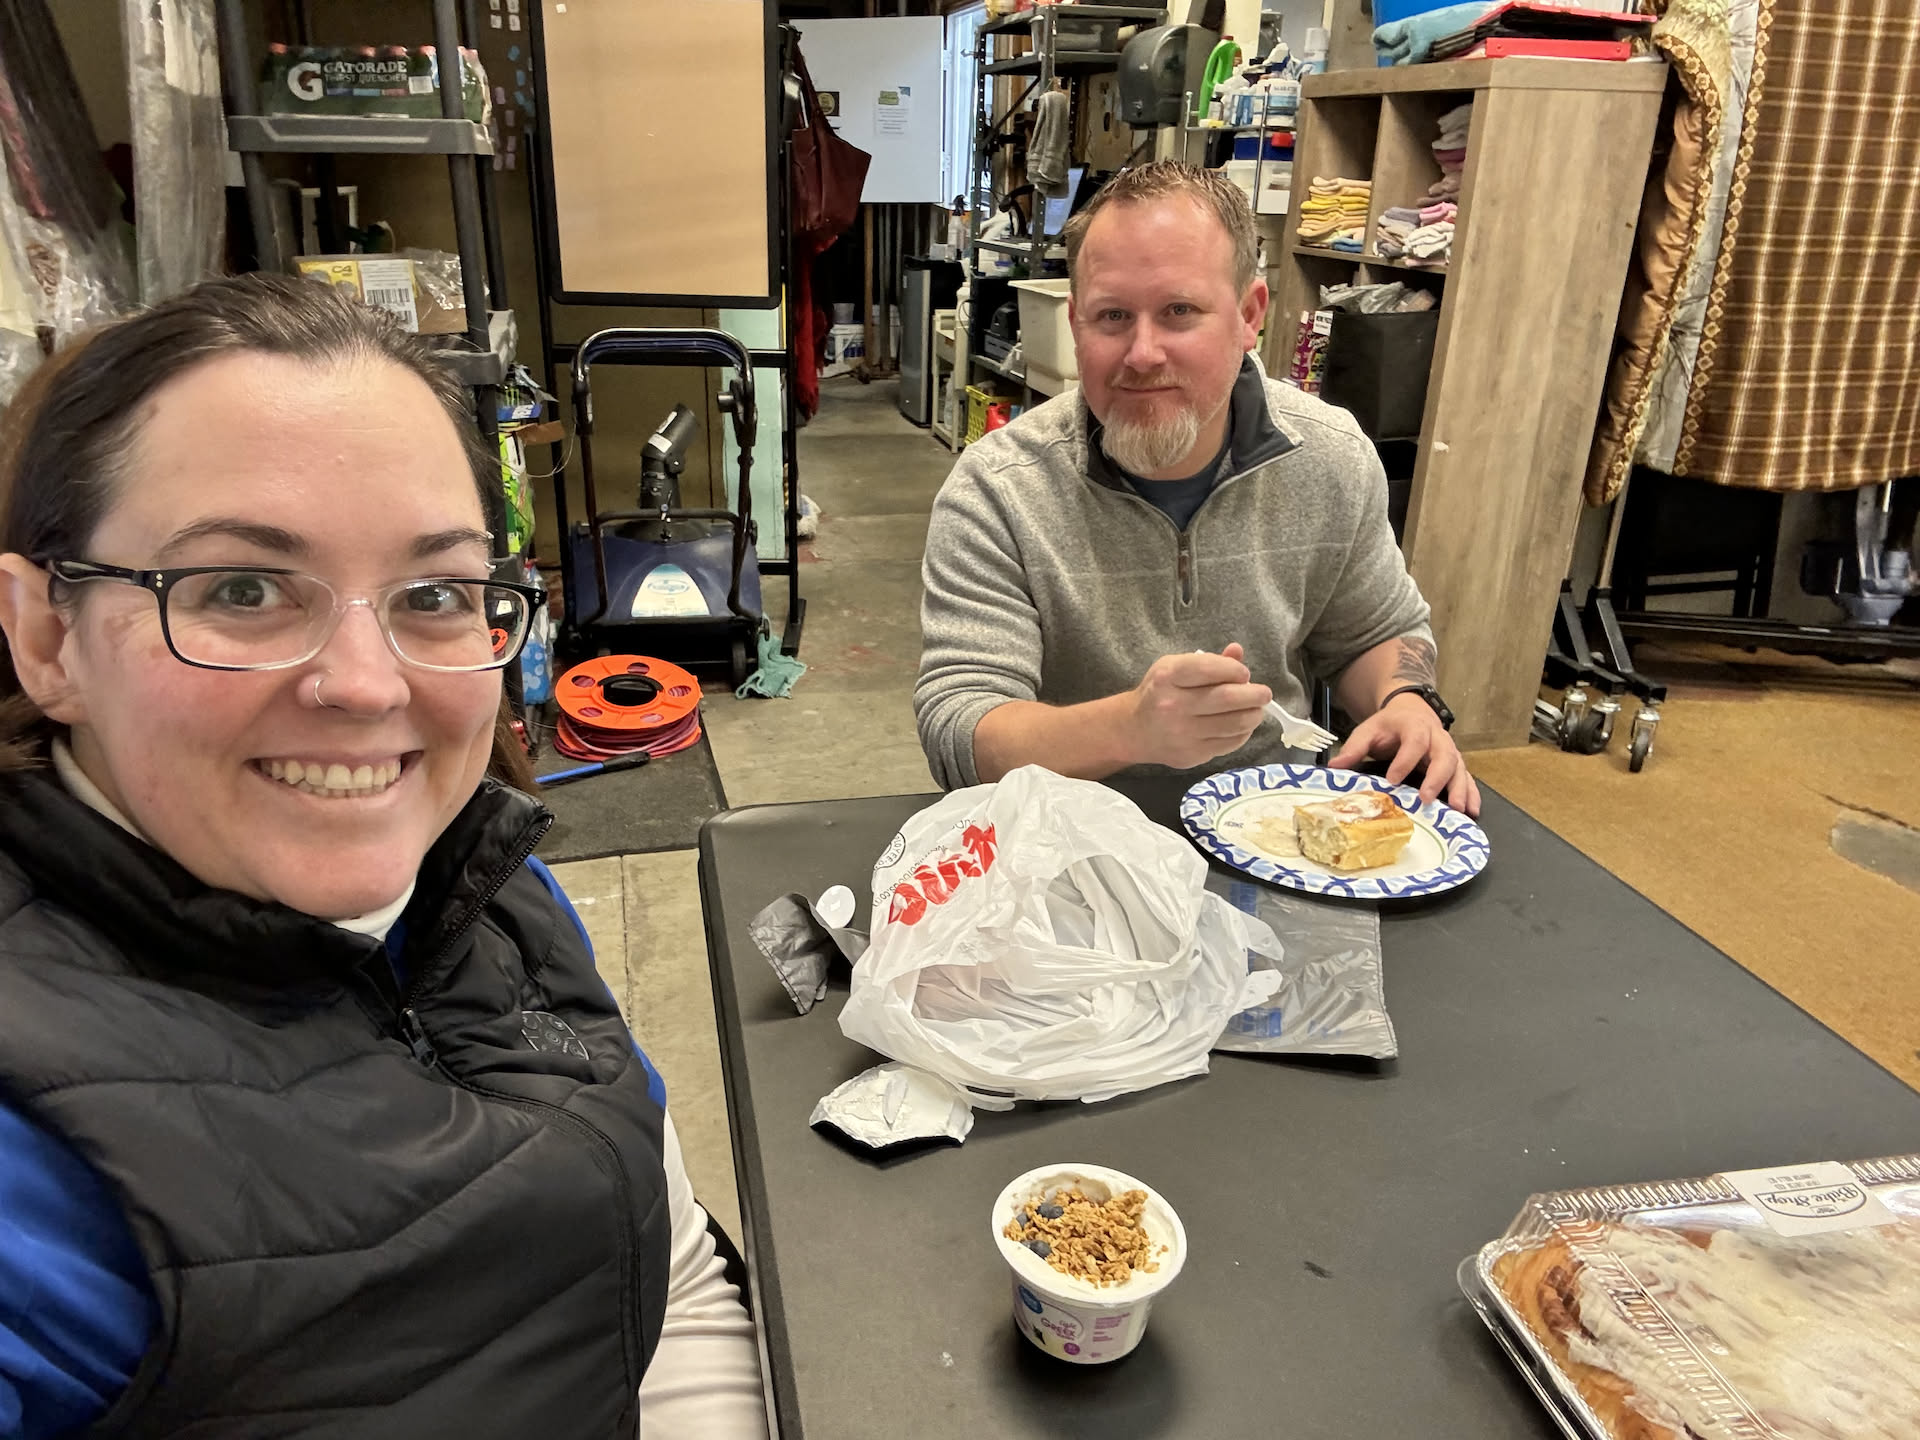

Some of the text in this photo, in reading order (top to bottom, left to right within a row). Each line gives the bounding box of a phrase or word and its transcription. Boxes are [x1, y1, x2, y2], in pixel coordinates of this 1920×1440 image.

[323, 61, 407, 74] GATORADE
[287, 62, 324, 101] G
[325, 73, 407, 84] THIRST QUENCHER
[1765, 1193, 1811, 1207] Shop
[1811, 1185, 1859, 1204] Bake
